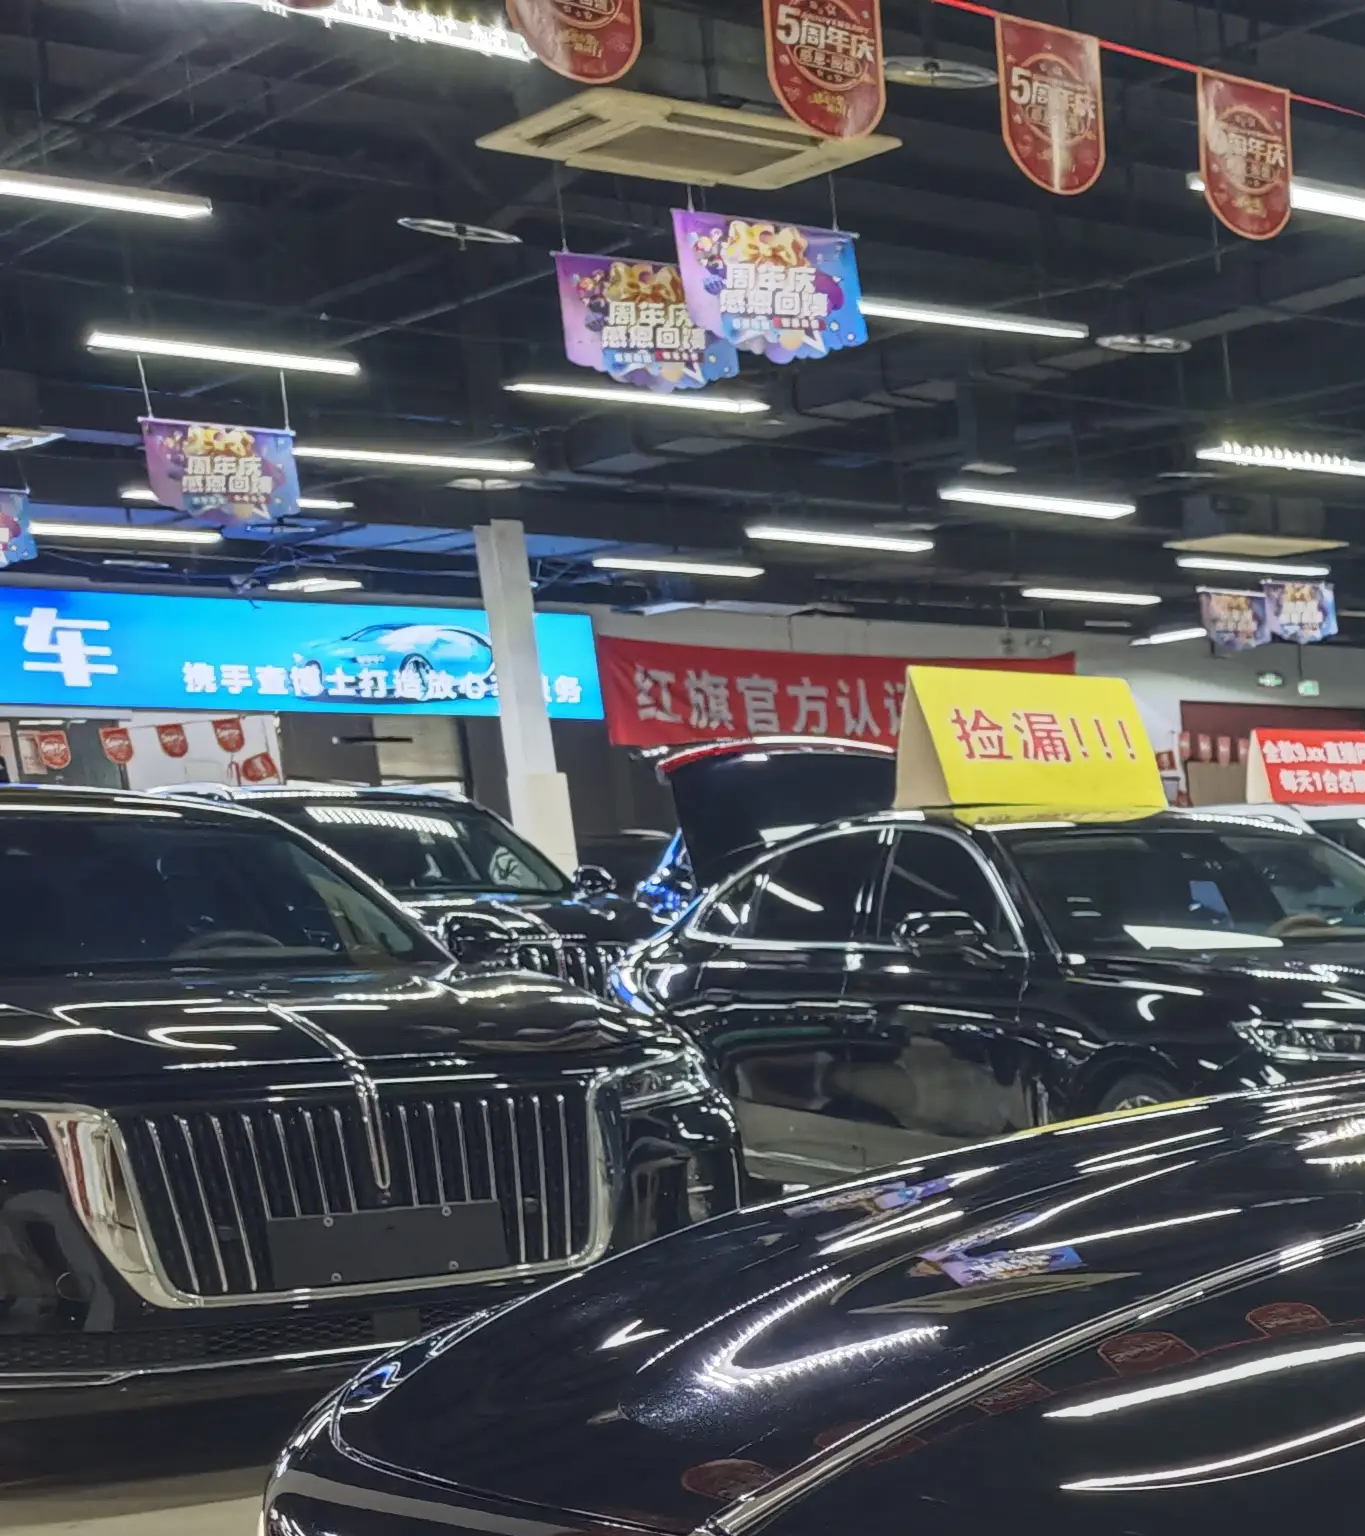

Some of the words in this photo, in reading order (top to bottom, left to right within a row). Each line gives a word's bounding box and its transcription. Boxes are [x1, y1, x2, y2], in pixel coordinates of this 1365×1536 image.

[776, 4, 875, 63] 5周年庆
[725, 263, 817, 292] 周年庆
[604, 301, 693, 327] 周年庆
[720, 289, 828, 317] 感恩回馈
[602, 326, 706, 351] 感恩回馈
[184, 455, 262, 477] 周年庆
[14, 607, 118, 687] 车
